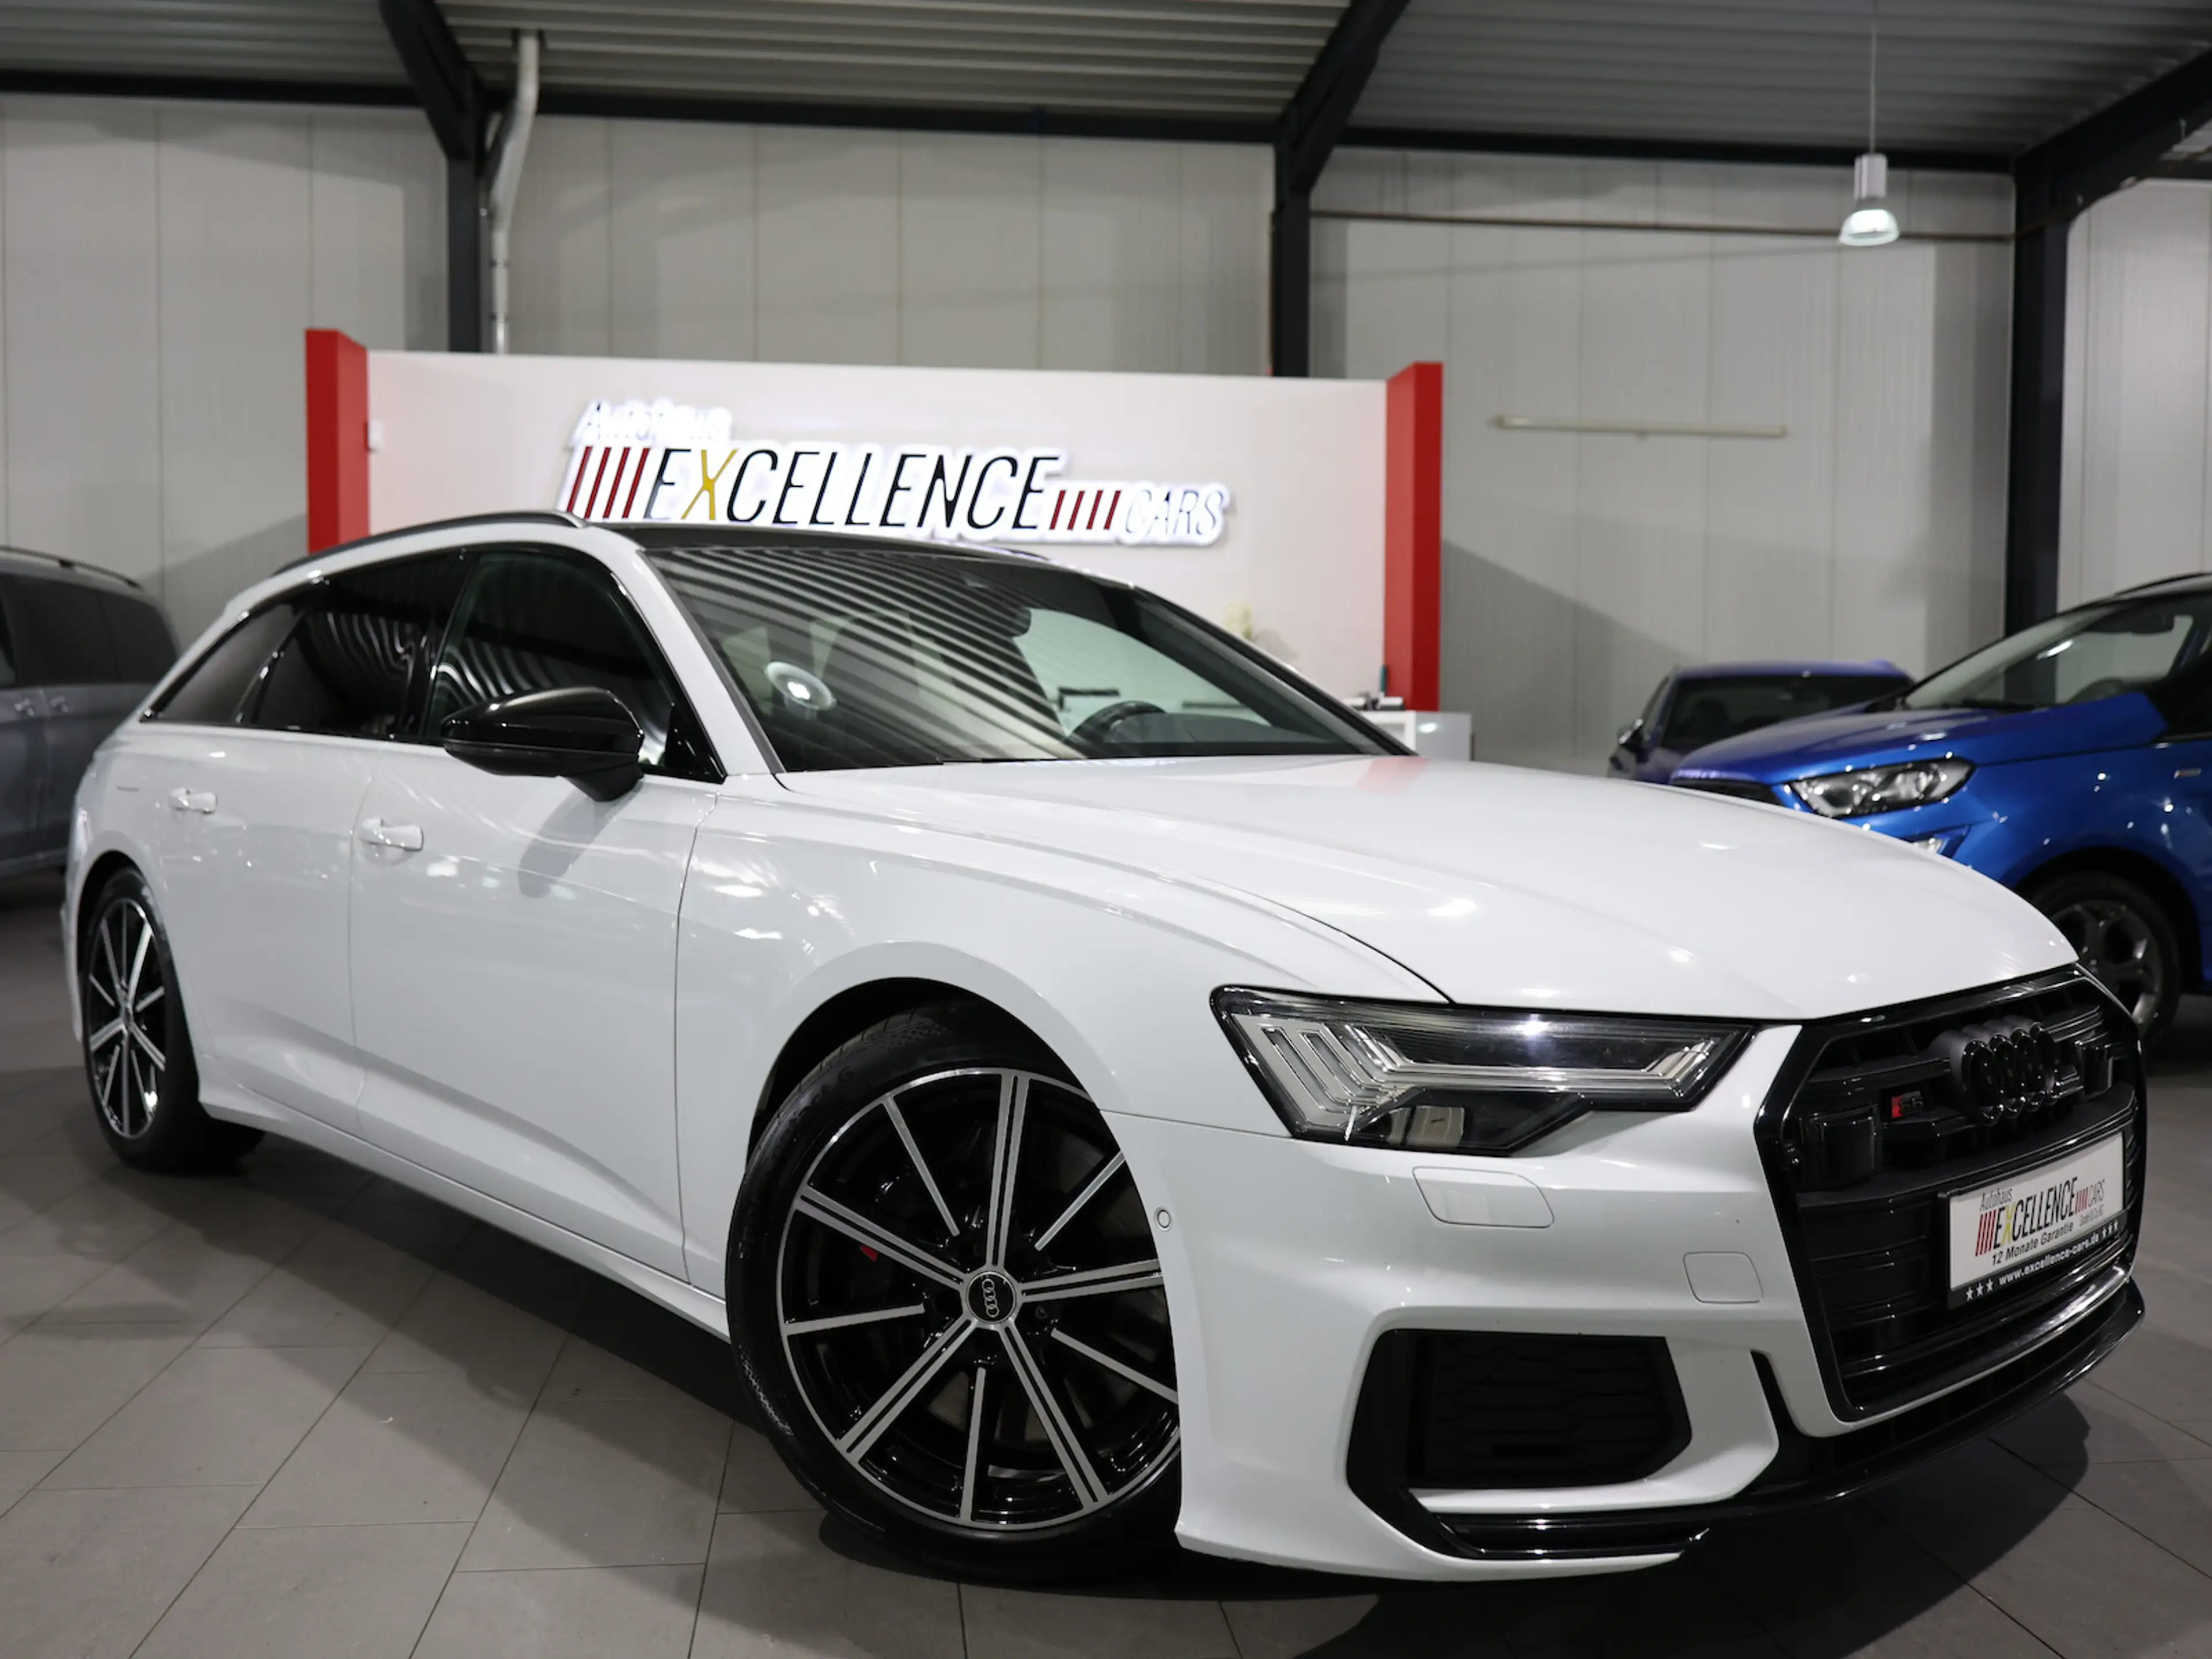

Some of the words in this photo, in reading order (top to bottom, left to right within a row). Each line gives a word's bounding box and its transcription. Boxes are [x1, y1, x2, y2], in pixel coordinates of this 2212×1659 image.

[643, 448, 1059, 529] EXCELLENCE
[1125, 489, 1225, 536] CARS
[1992, 1251, 2003, 1266] 12
[2005, 1237, 2039, 1262] Monate
[2040, 1221, 2074, 1246] Garantie
[1994, 1176, 2078, 1249] EXCELLENCE
[1998, 1232, 2100, 1286] www.excellence-cars.de
